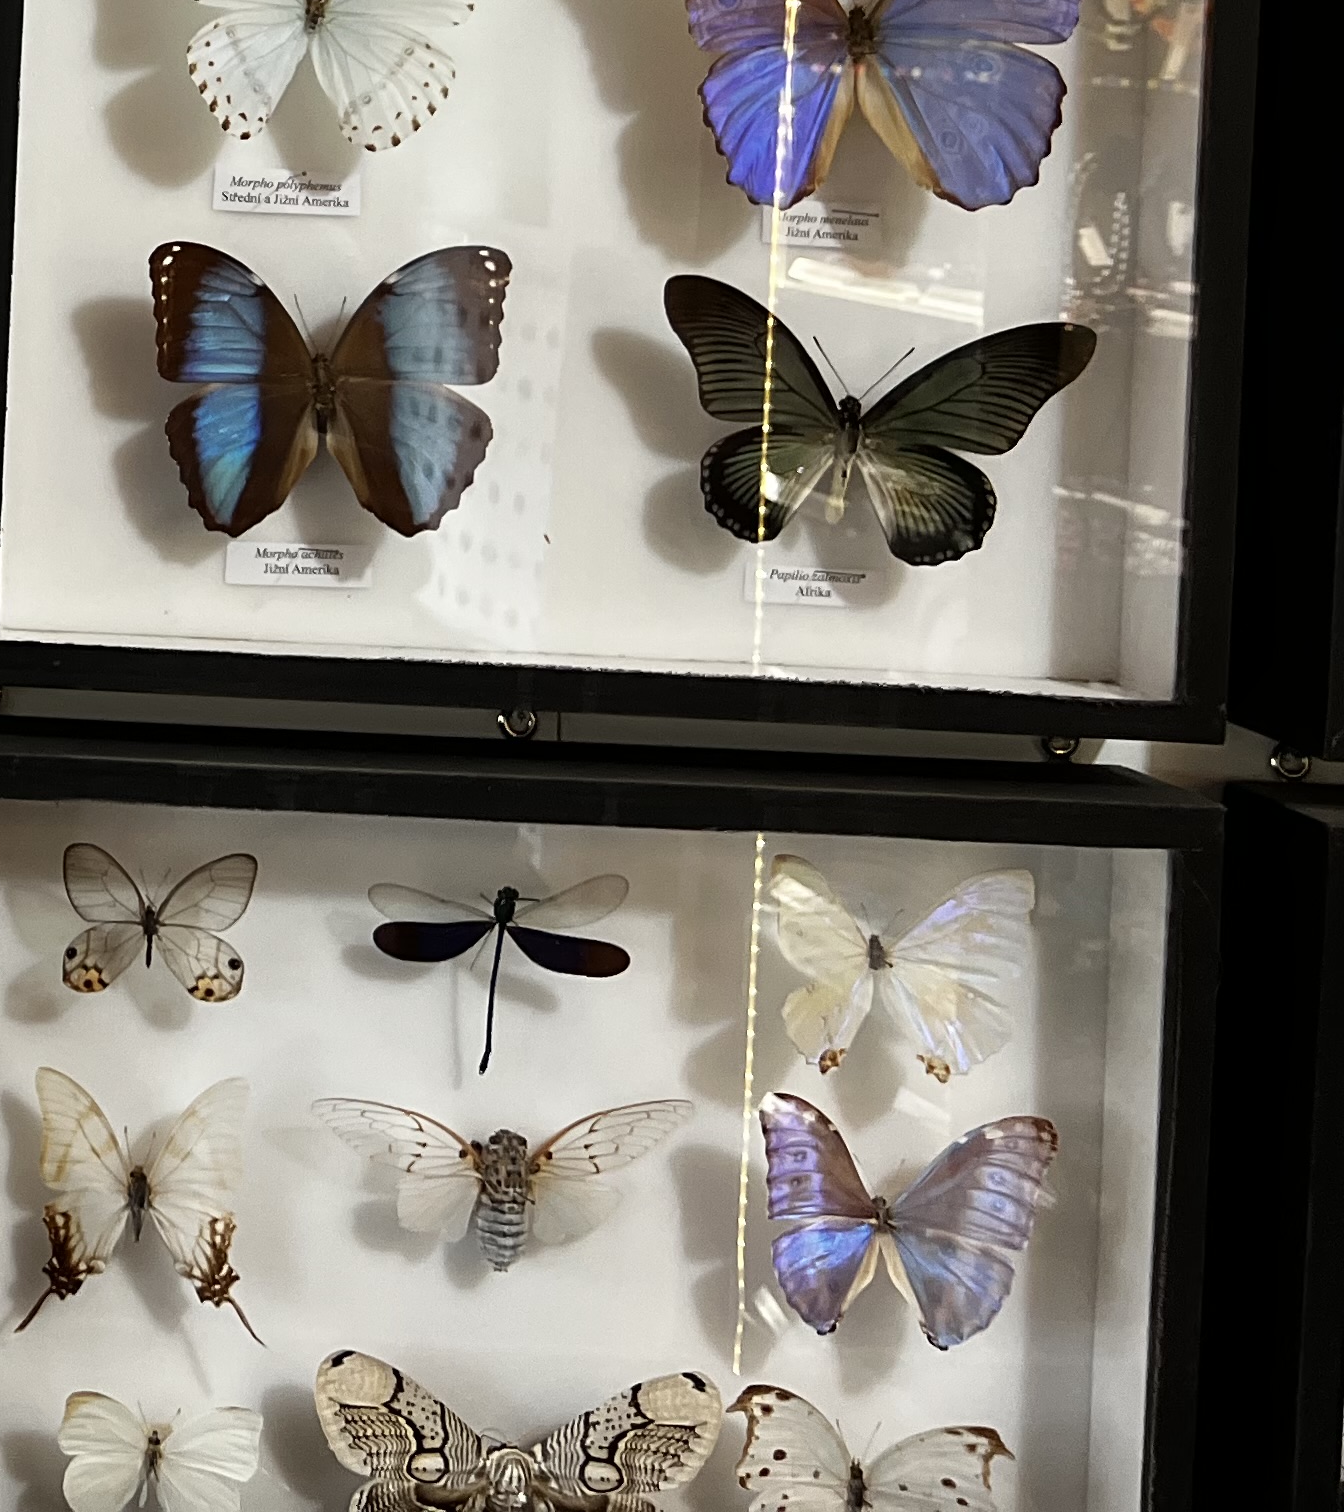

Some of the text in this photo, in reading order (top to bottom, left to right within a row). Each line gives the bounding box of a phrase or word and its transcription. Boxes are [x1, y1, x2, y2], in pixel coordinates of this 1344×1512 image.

[230, 175, 342, 194] Morpho polyphemus
[221, 191, 350, 209] Střední a Jižní Amerika
[786, 227, 859, 241] Jižní Amerika
[255, 548, 298, 561] Morpho
[263, 563, 340, 576] Jižní Amerika
[769, 569, 809, 583] Papilio
[796, 586, 831, 598] Afrika
